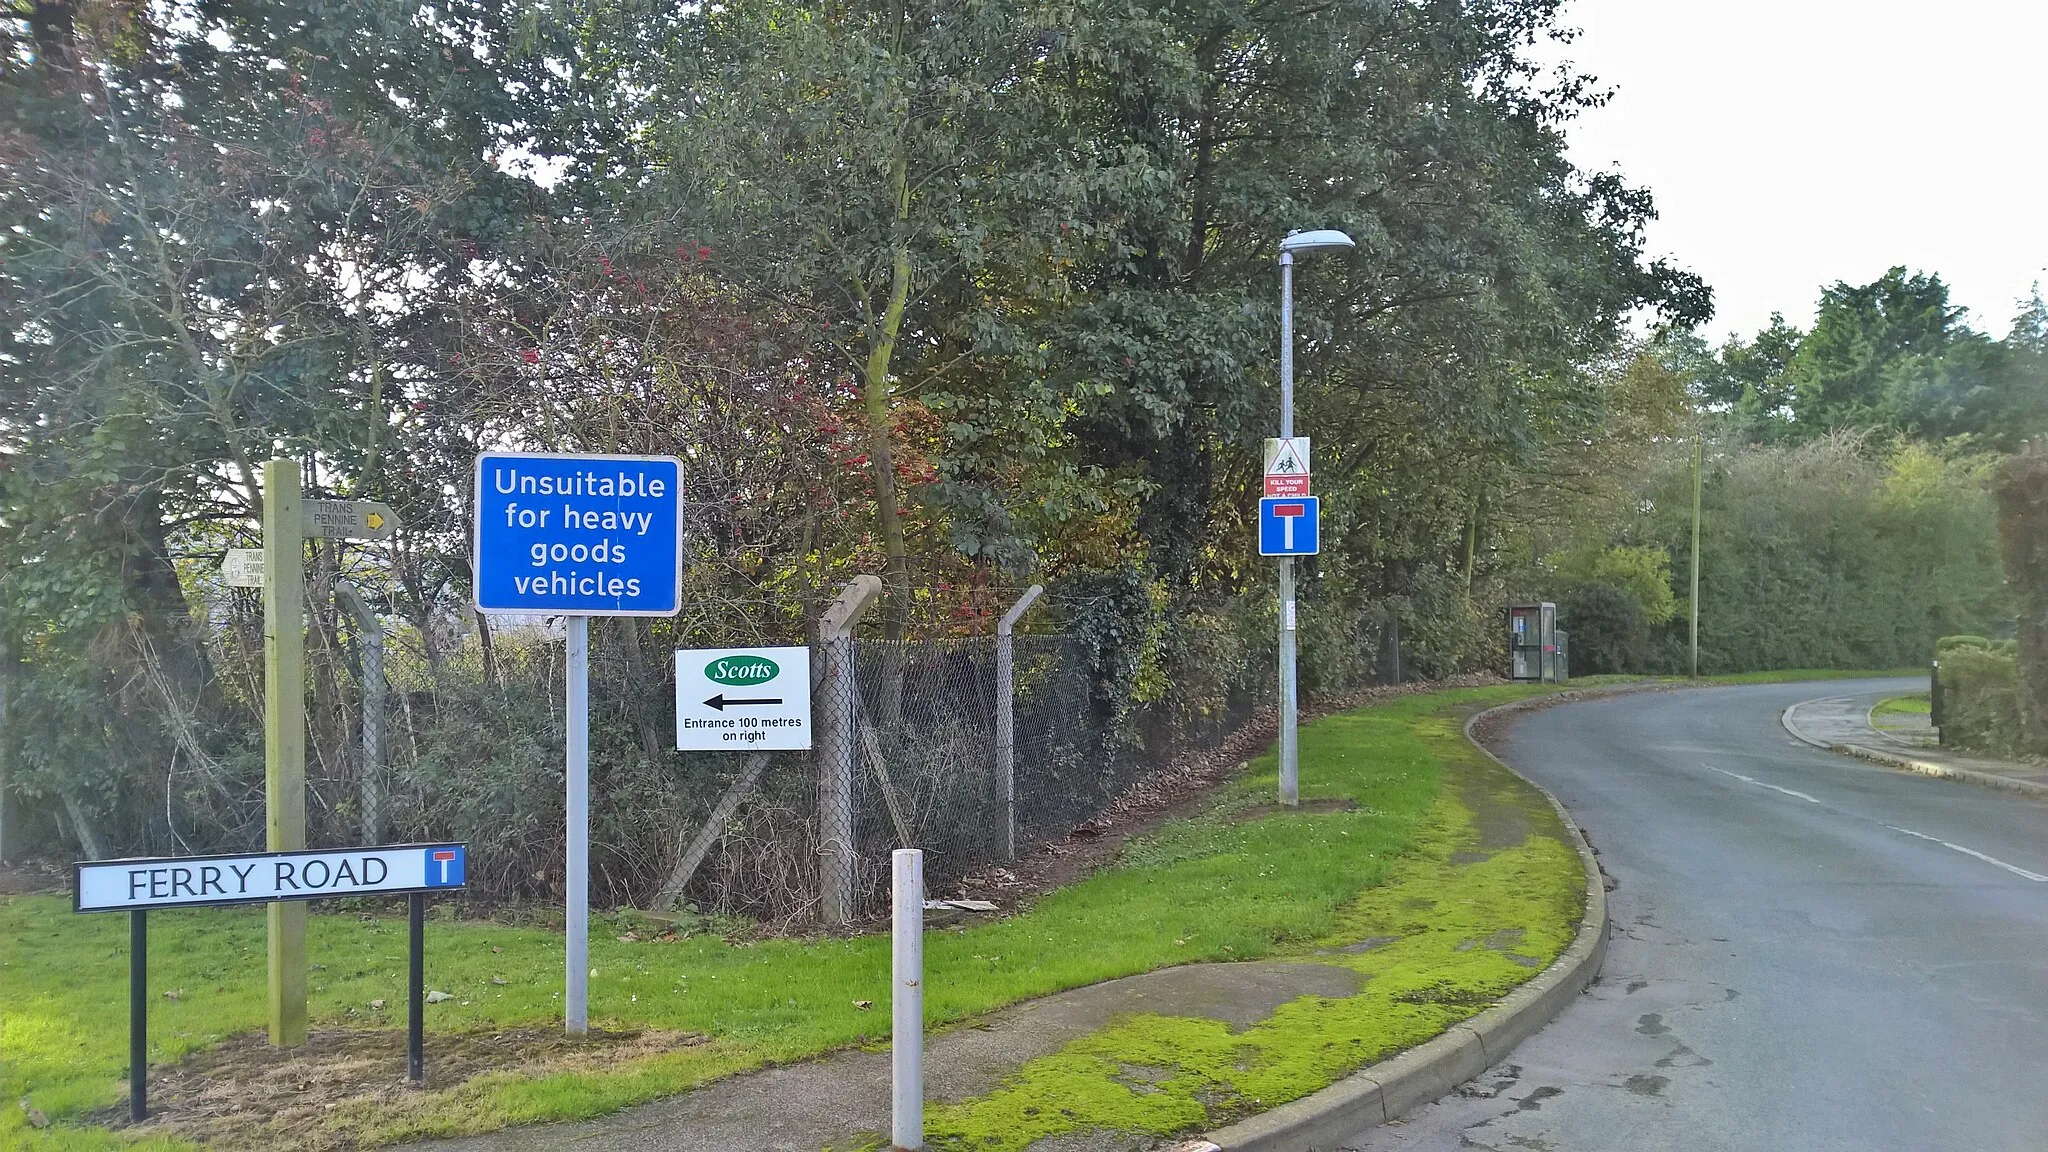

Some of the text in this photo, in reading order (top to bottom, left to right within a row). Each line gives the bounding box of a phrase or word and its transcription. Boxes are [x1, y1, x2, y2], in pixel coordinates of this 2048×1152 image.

[495, 468, 665, 498] Unsuitable
[317, 502, 353, 513] TRANS
[314, 513, 357, 525] PENNINE
[505, 503, 653, 536] for heavy
[321, 525, 353, 536] TRAIL
[530, 538, 626, 567] goods
[514, 570, 641, 597] vehicles
[714, 660, 772, 679] Scotts
[684, 717, 802, 729] Entrance 100 metres
[722, 730, 766, 743] on right
[127, 857, 388, 900] FERRY ROAD
